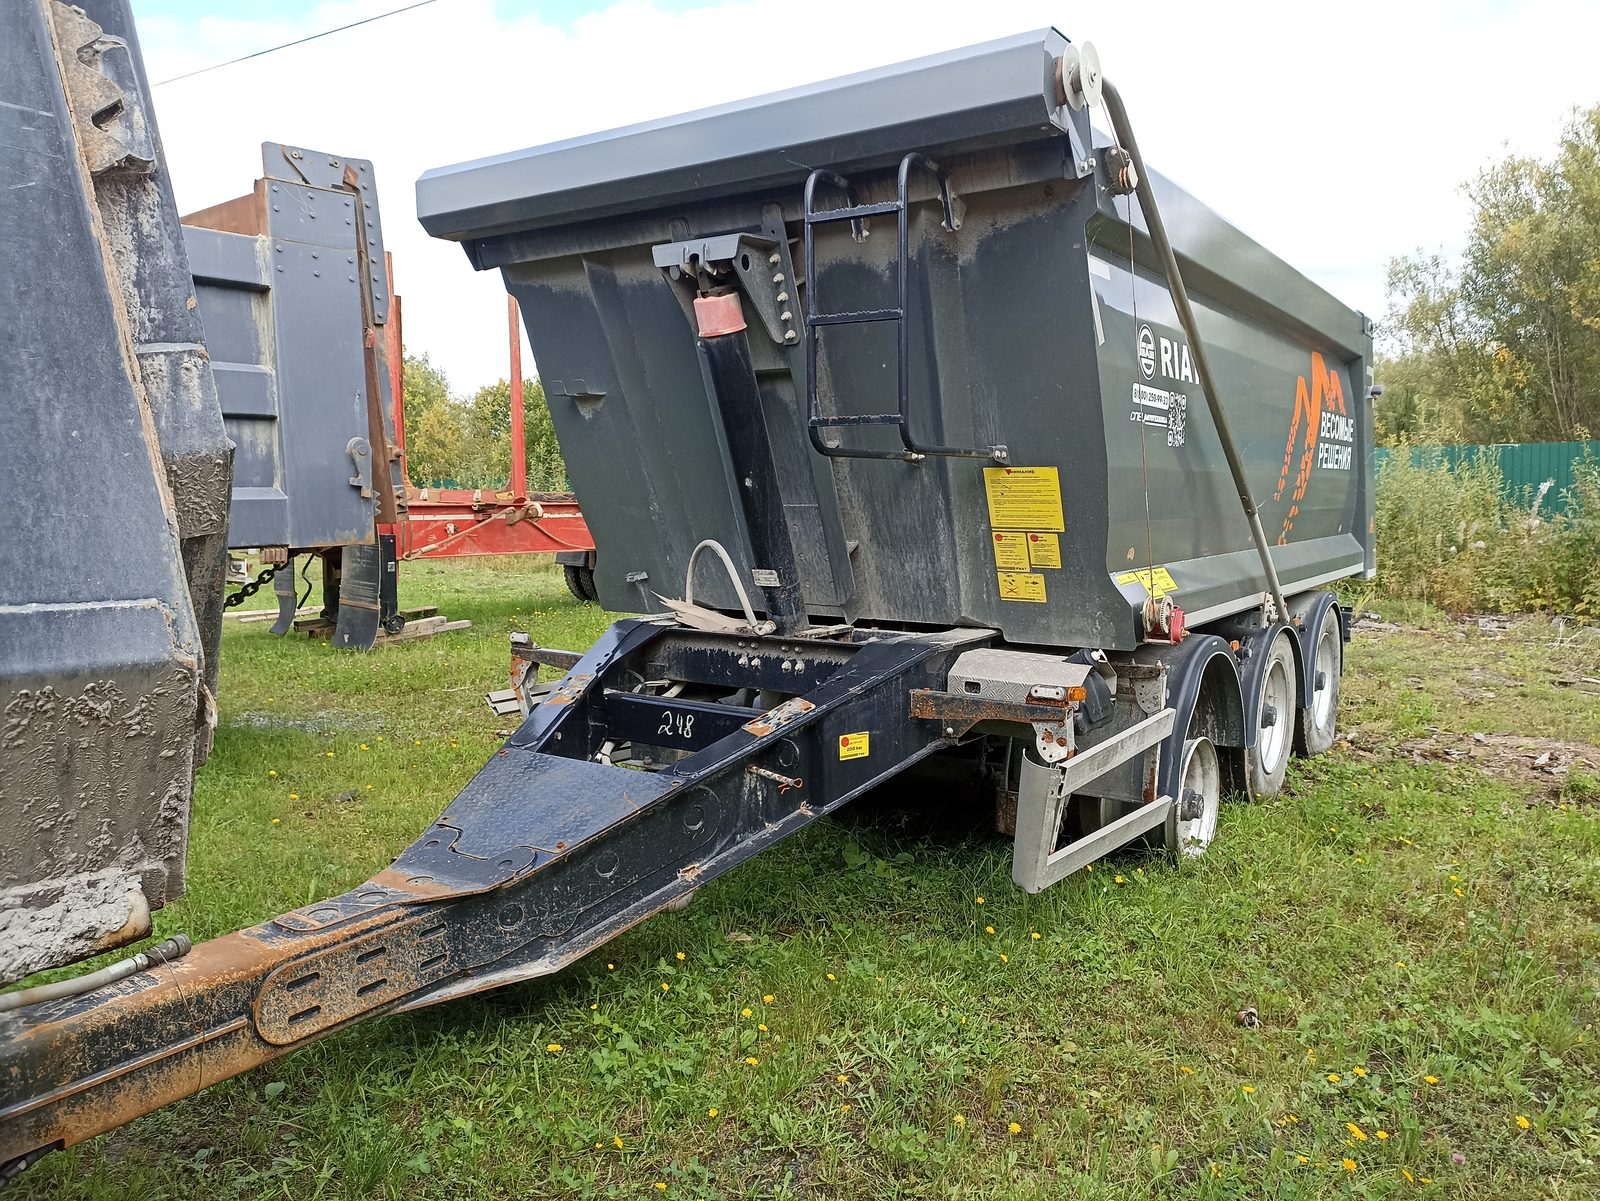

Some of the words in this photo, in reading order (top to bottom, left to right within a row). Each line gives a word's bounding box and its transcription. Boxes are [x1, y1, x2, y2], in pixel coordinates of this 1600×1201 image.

[1320, 411, 1354, 443] ВЕСОМЫЕ
[1317, 442, 1352, 470] РЕШЕНИЯ
[657, 710, 695, 739] 248
